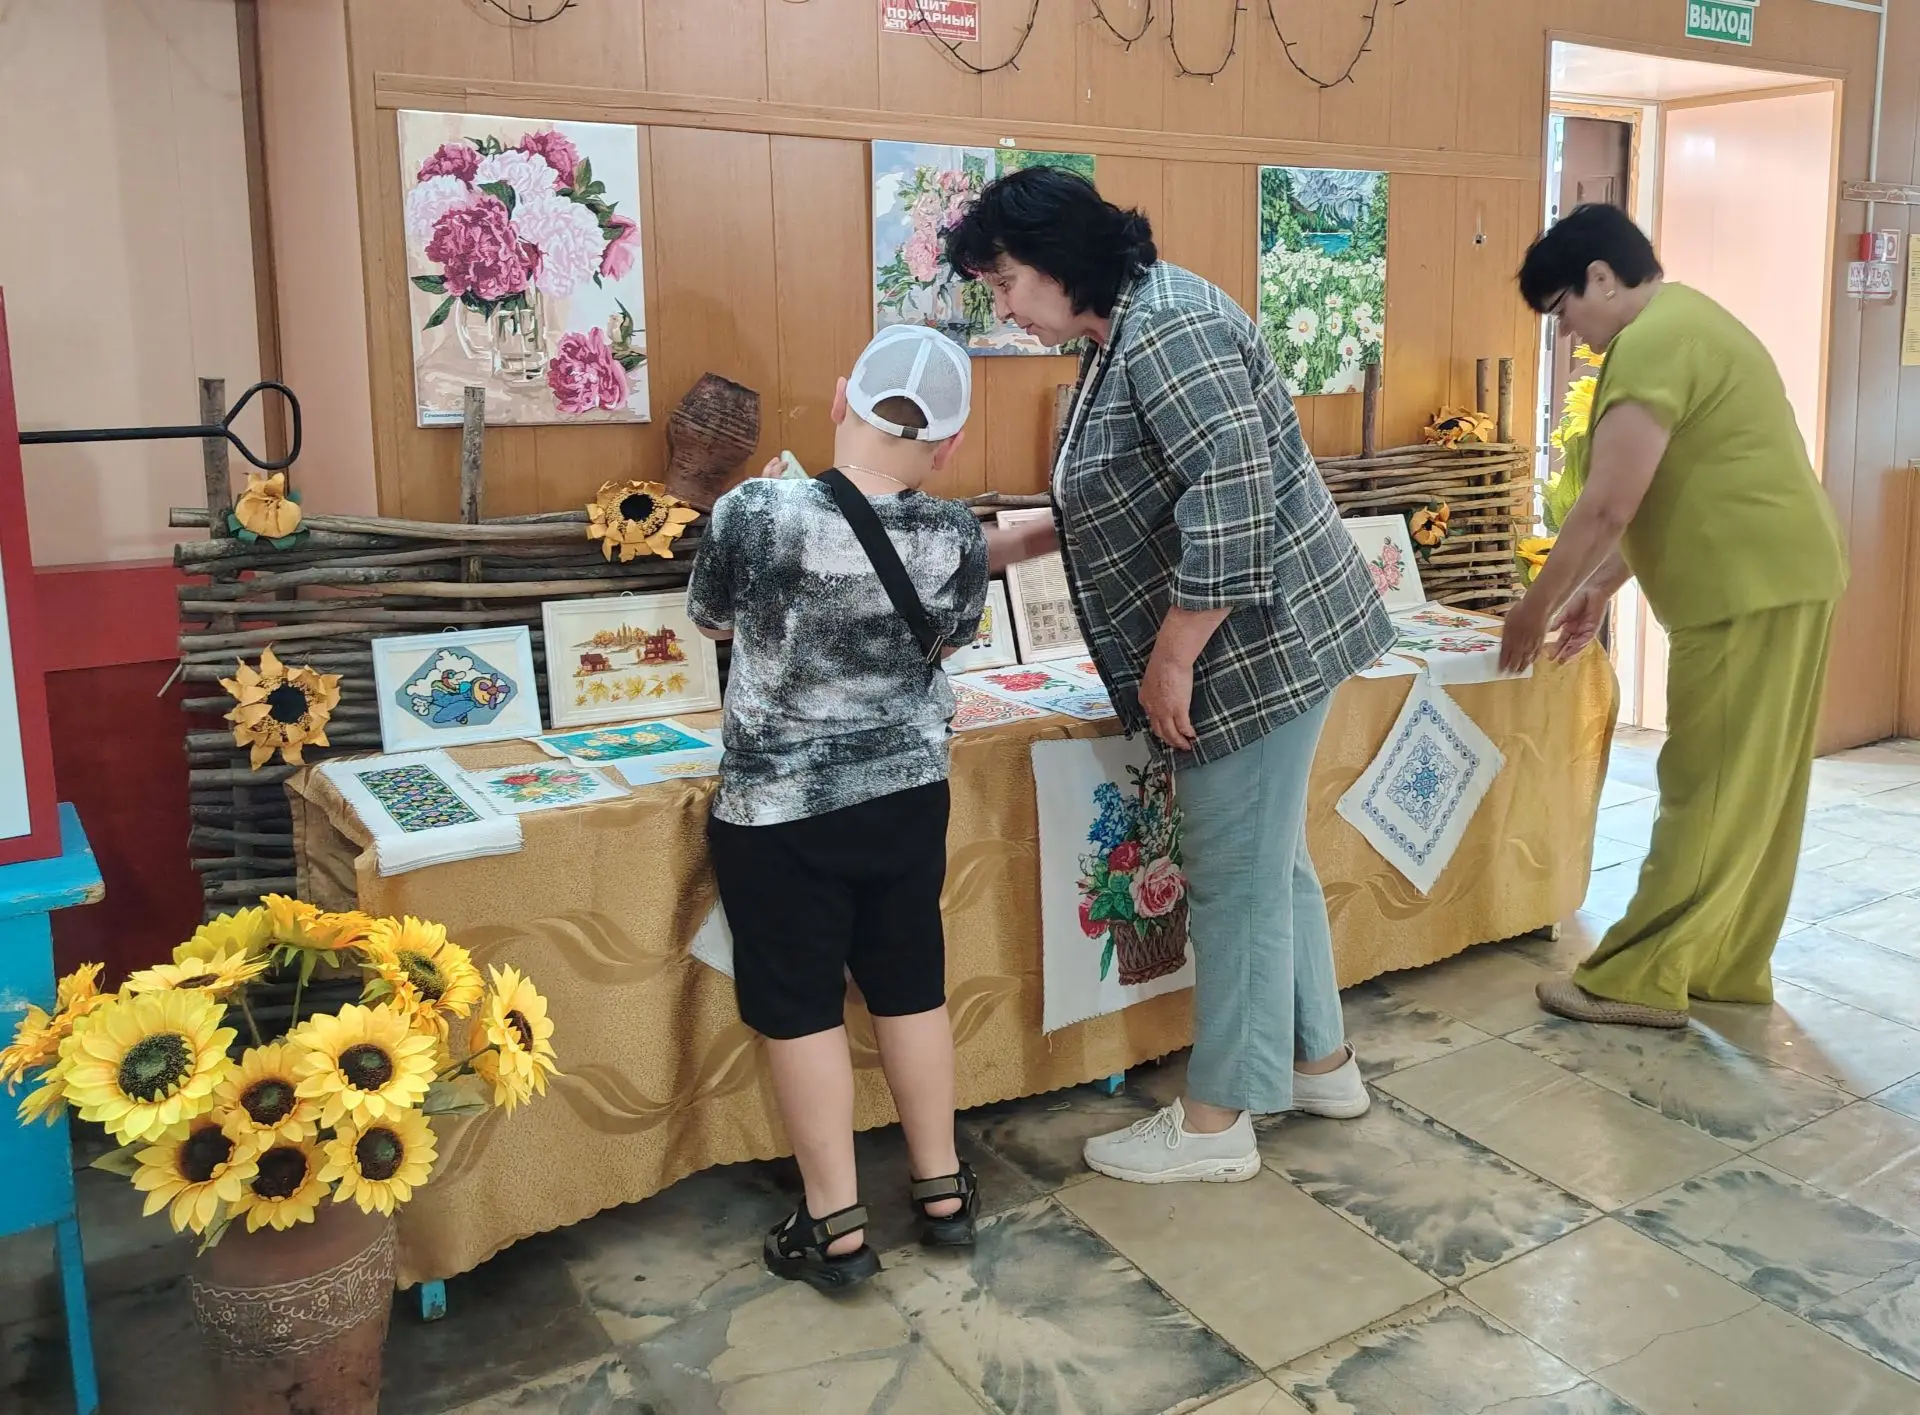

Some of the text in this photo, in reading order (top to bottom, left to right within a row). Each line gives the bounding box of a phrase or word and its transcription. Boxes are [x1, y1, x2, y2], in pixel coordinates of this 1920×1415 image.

[915, 0, 948, 12] ЩИТ
[887, 7, 976, 28] ПОЖАРНЫЙ
[1689, 4, 1751, 41] ВЫХОД
